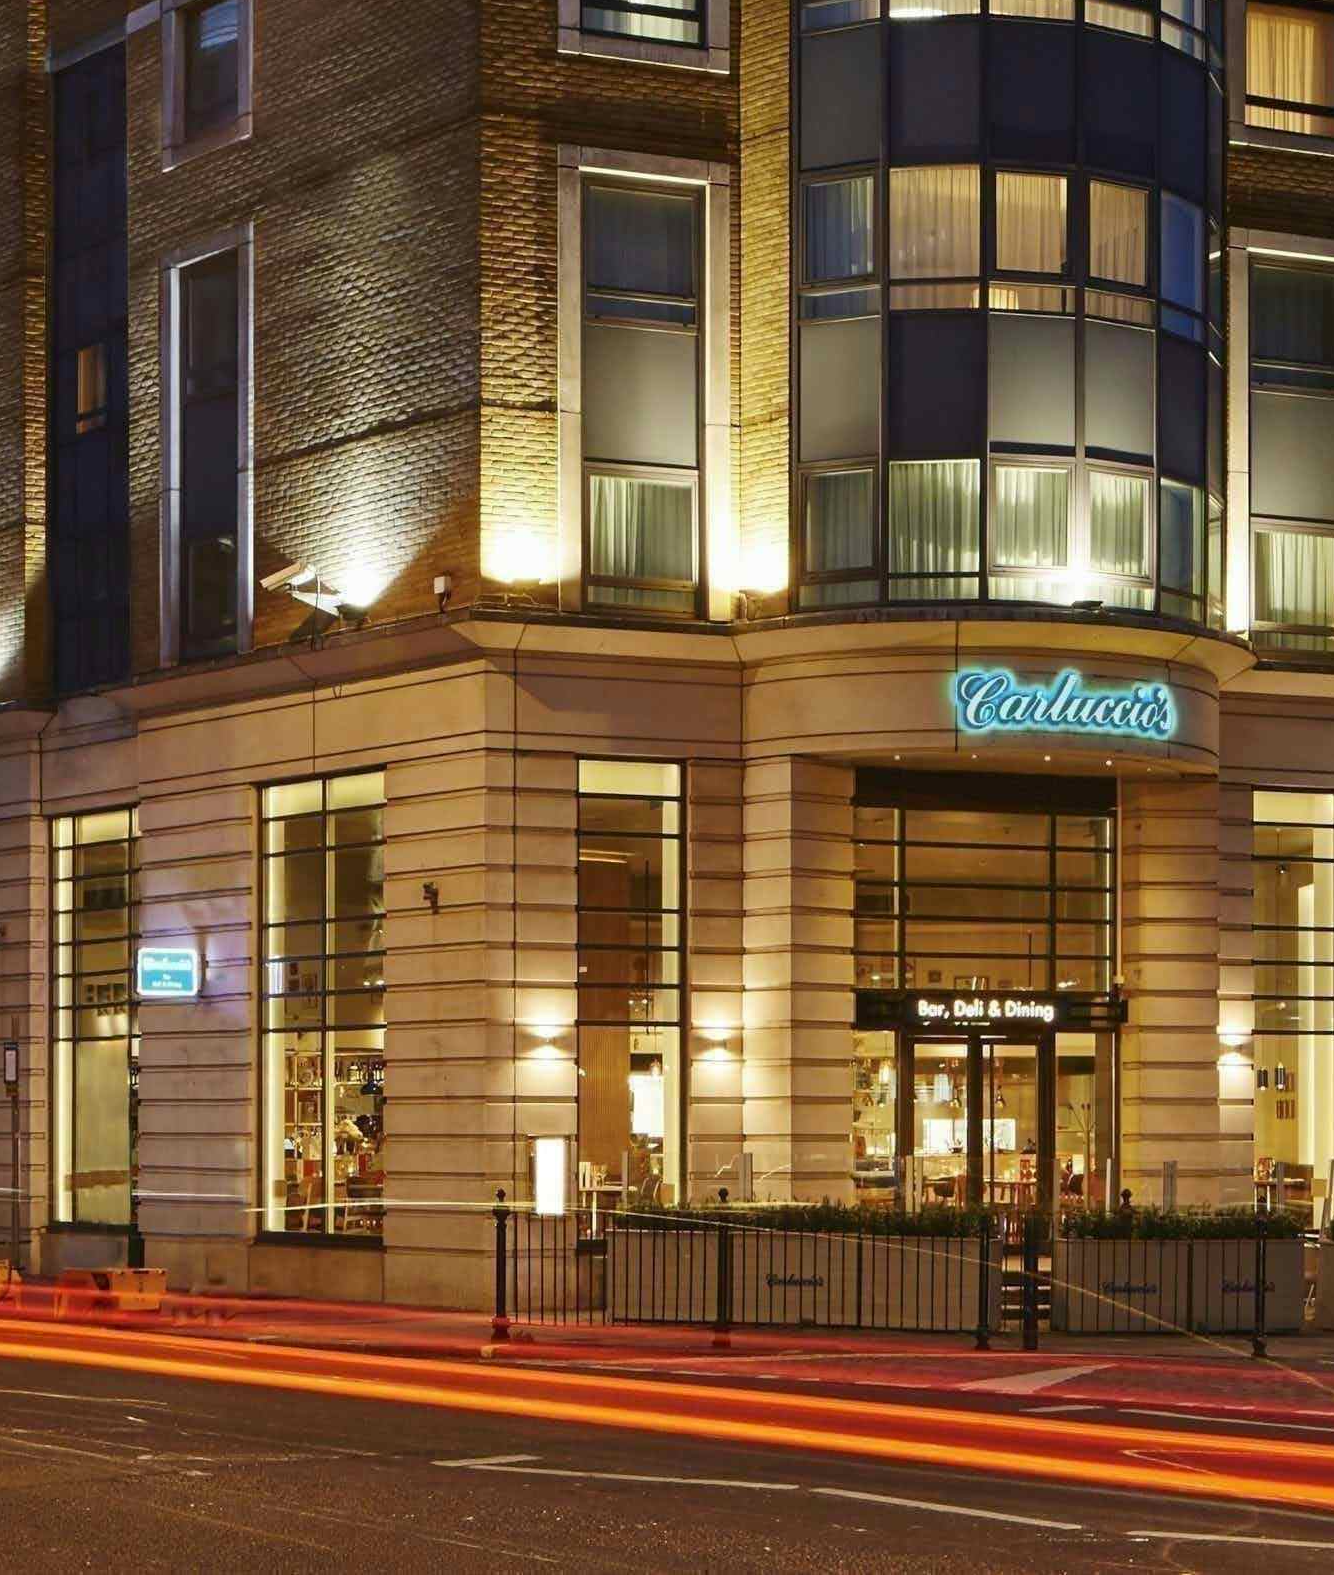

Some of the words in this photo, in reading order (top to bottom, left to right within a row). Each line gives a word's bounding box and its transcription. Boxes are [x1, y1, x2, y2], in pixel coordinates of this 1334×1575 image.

[961, 673, 1171, 730] Carluccio's
[918, 999, 950, 1019] Bar,
[953, 998, 984, 1017] Deli
[988, 999, 1001, 1018] &
[1004, 999, 1054, 1023] Dining
